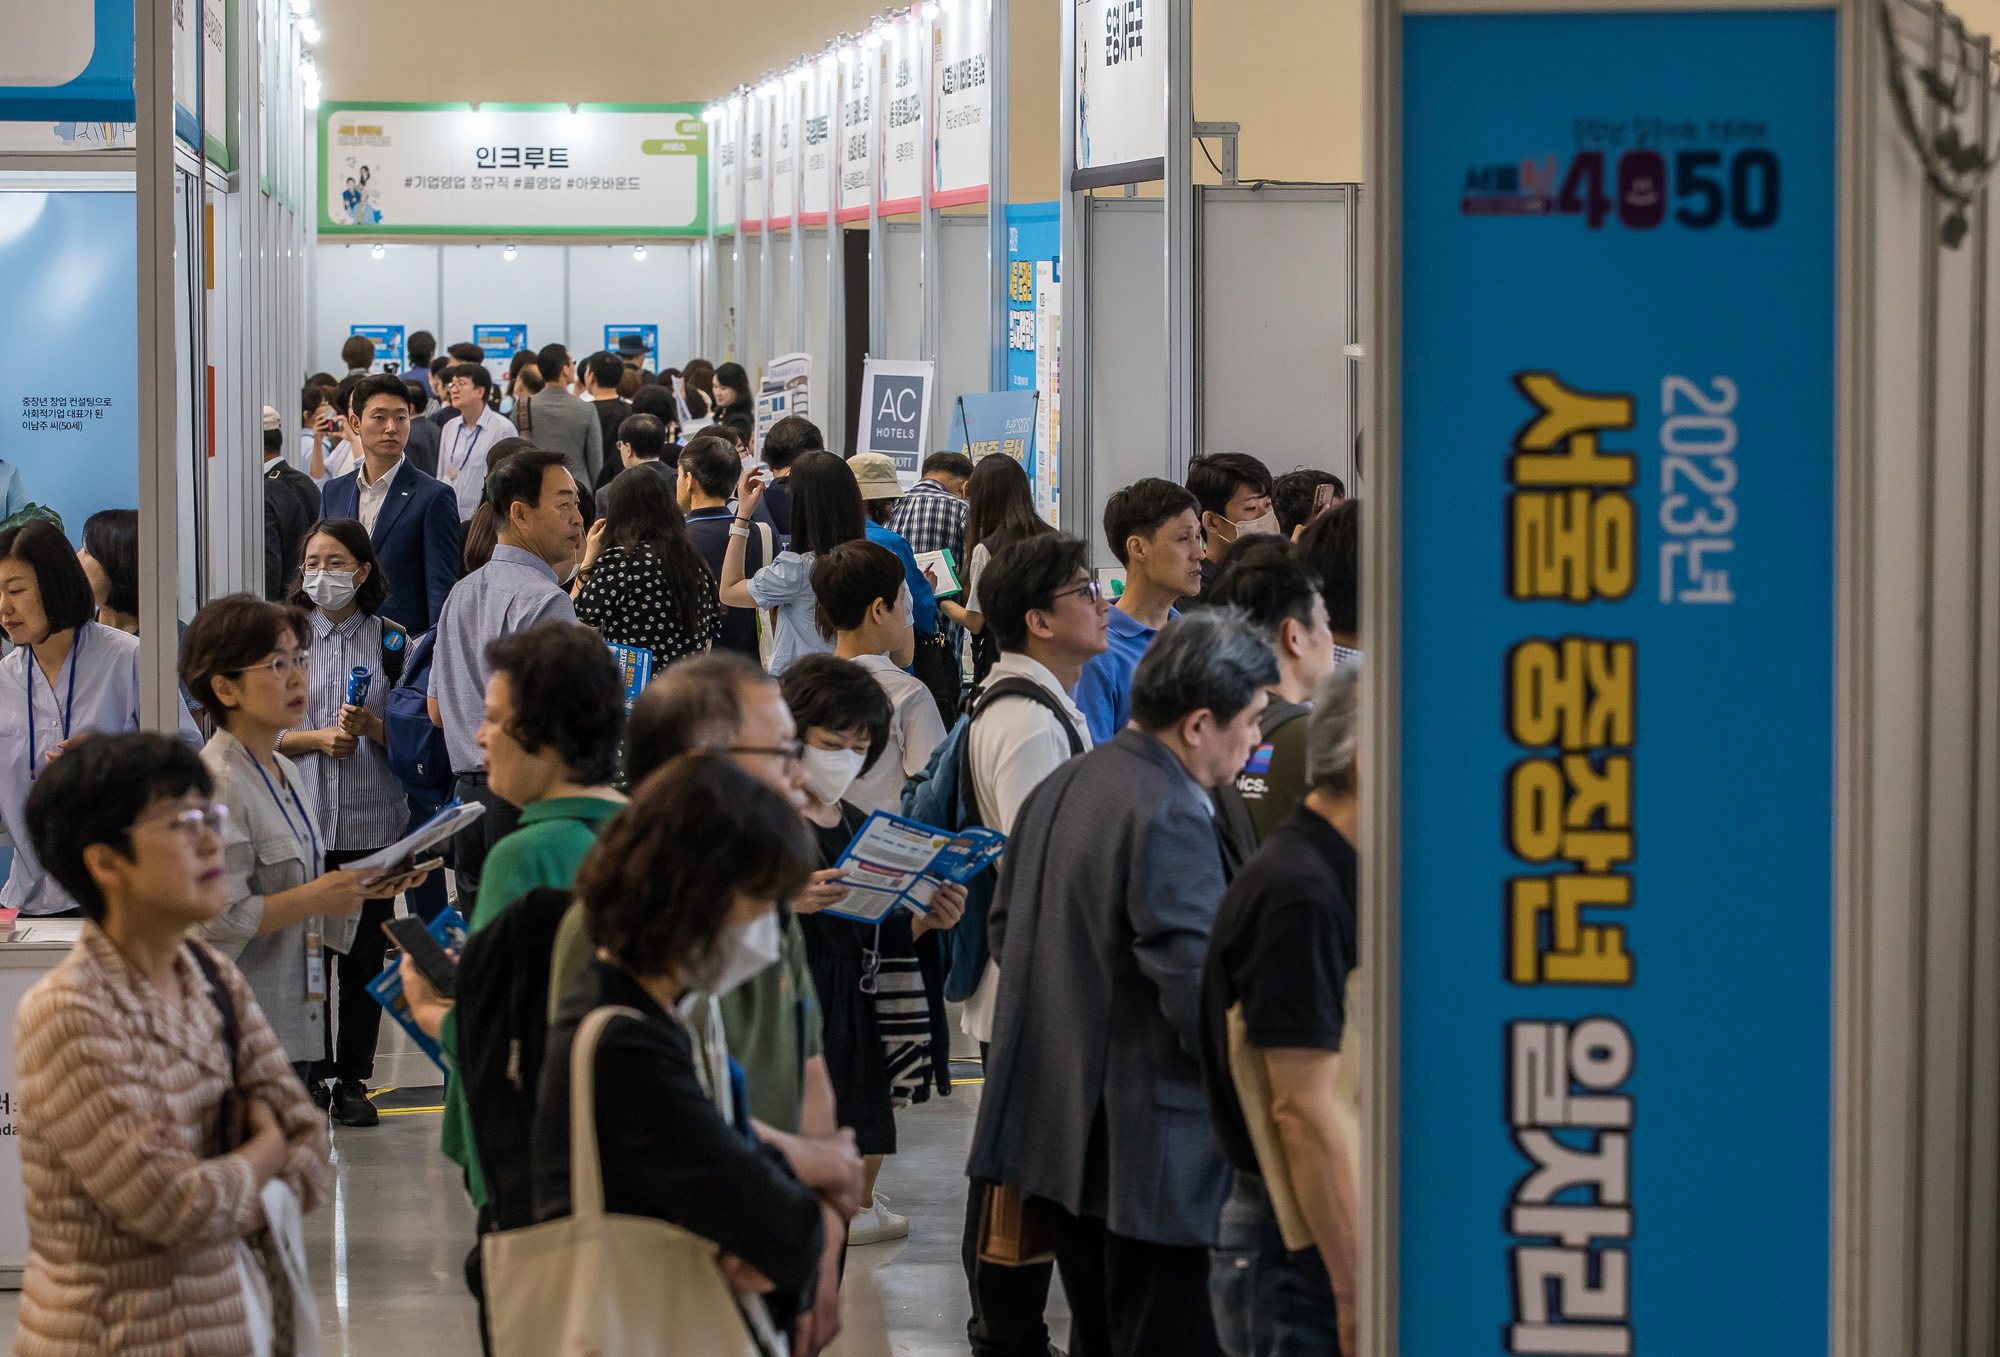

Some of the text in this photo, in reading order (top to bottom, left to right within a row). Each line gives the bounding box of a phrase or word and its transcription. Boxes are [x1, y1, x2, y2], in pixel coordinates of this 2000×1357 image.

[476, 147, 569, 170] 인크루트
[404, 176, 641, 190] #기업영업 정규직 #콜영업 #아웃바운드
[22, 396, 112, 407] 중장년 창업 컨설팅으로
[877, 387, 917, 423] AC
[22, 408, 103, 419] 사회적기업 대표가 된
[22, 421, 83, 432] 이남주 씨(50세)
[876, 427, 915, 439] HOTELS
[1505, 371, 1637, 606] 서울
[1659, 375, 1738, 605] 2023년
[1505, 634, 1637, 987] 중장년
